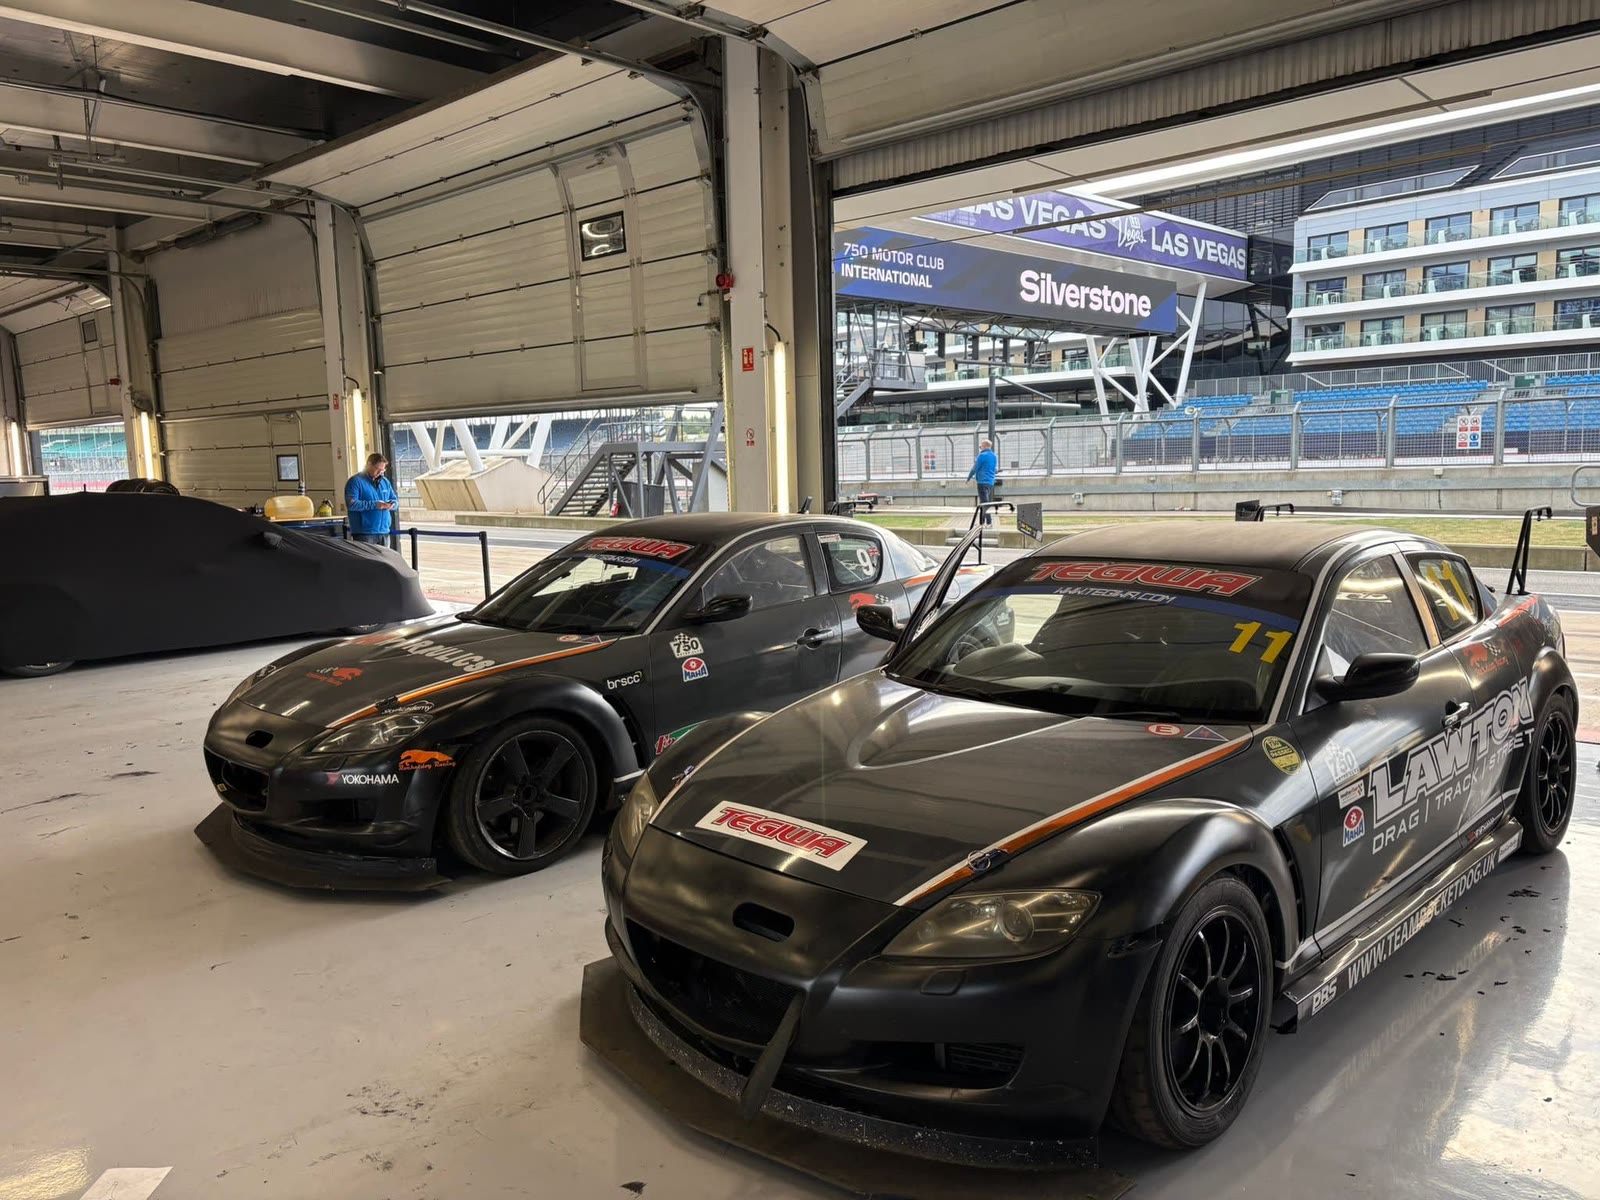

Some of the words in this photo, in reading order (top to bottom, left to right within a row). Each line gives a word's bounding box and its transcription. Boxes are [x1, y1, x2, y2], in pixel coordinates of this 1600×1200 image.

[1019, 197, 1106, 239] VEGAS
[843, 242, 869, 259] 750
[872, 247, 913, 266] MOTOR
[916, 254, 944, 270] CLUB
[1151, 226, 1189, 257] LAS
[1193, 237, 1246, 270] VEGAS
[841, 263, 932, 288] INTERNATIONAL
[1020, 270, 1151, 317] Silverstone
[856, 548, 875, 577] 9
[1024, 561, 1263, 597] TEGIWA
[673, 640, 699, 654] 750
[1228, 621, 1293, 664] 11
[606, 673, 641, 690] brscc
[684, 667, 706, 680] MAHA
[1367, 676, 1534, 829] LAWTON
[341, 774, 399, 785] YOKOHAMA
[1372, 809, 1420, 855] DRAG
[1435, 766, 1480, 811] TRACK
[1488, 728, 1535, 771] STREET
[711, 806, 852, 858] TEGIWA
[1343, 818, 1364, 844] MAHA
